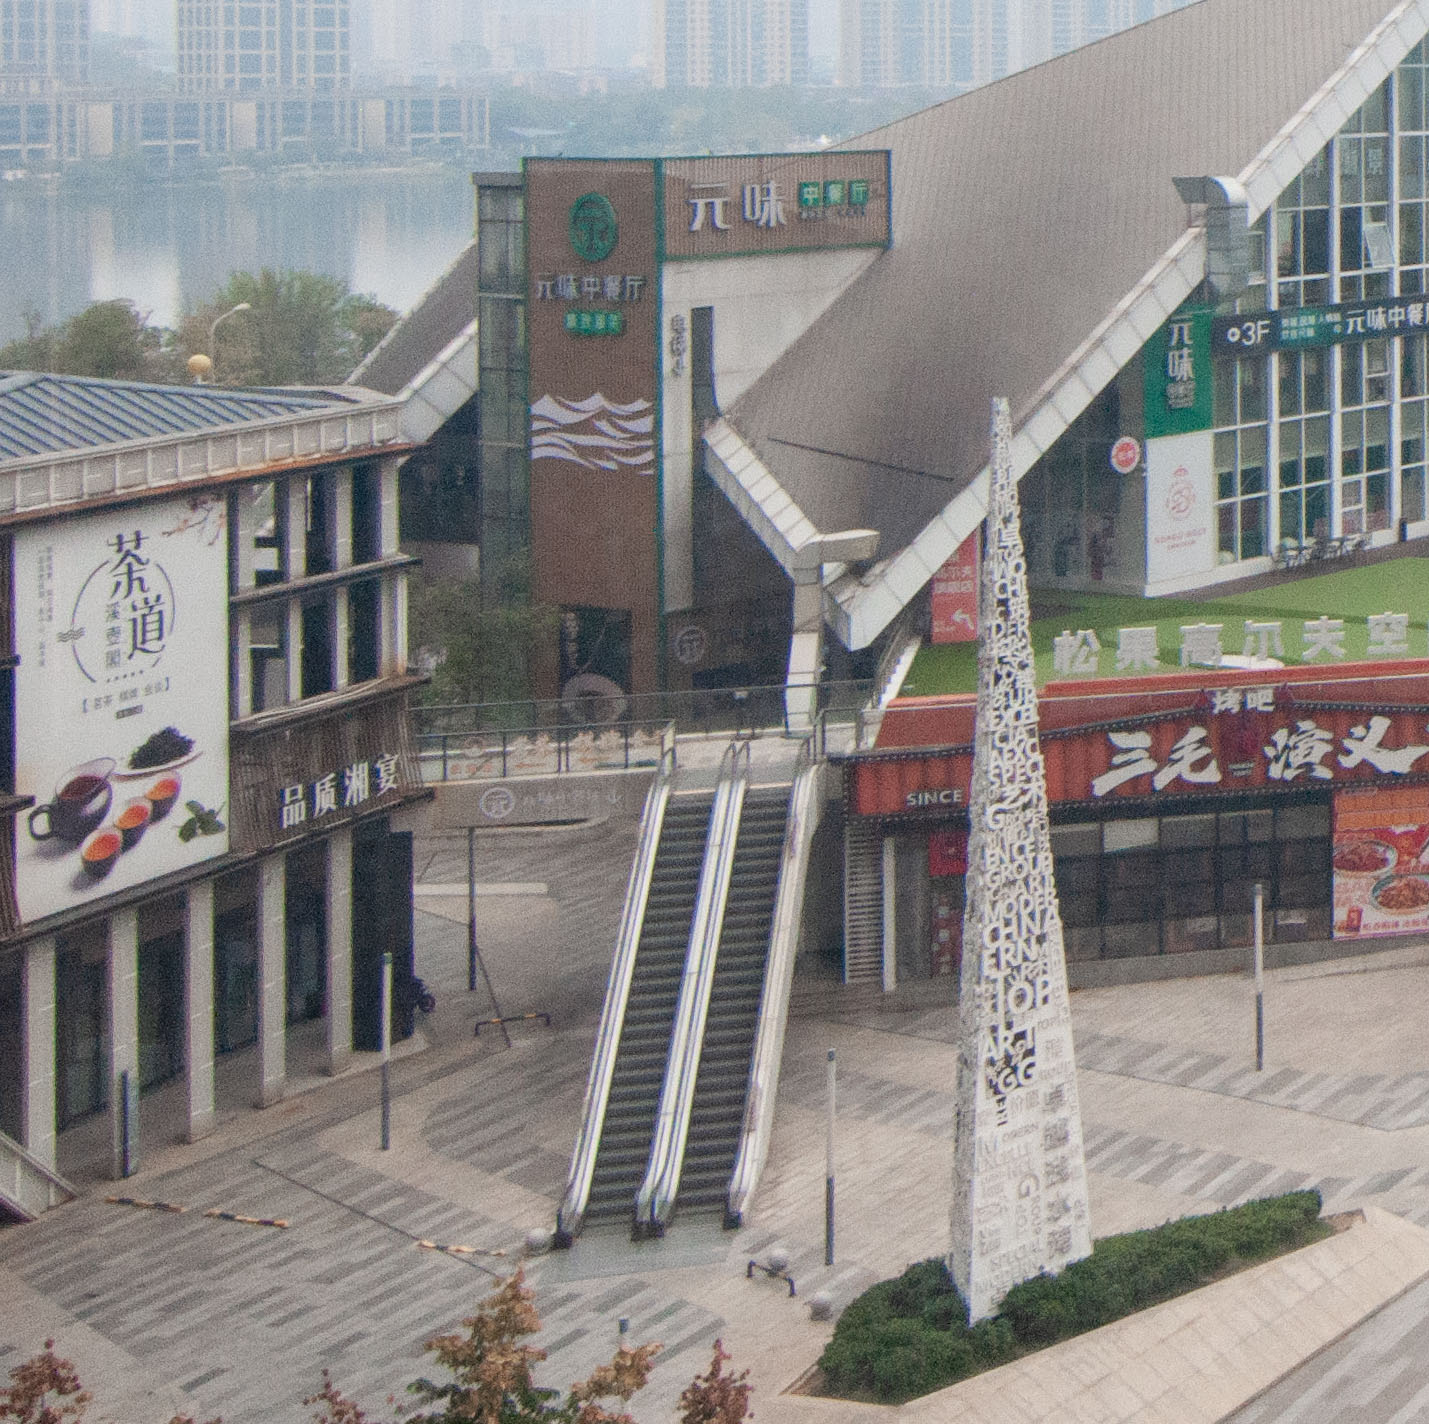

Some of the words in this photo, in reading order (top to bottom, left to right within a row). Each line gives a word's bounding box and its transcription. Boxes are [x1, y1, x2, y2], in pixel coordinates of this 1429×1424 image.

[687, 180, 787, 233] 元味
[536, 274, 648, 303] 元味中餐厅
[1241, 320, 1271, 346] 3F
[1211, 687, 1275, 714] 烤吧
[282, 753, 399, 829] 品质湘宴
[906, 789, 963, 807] SINCE
